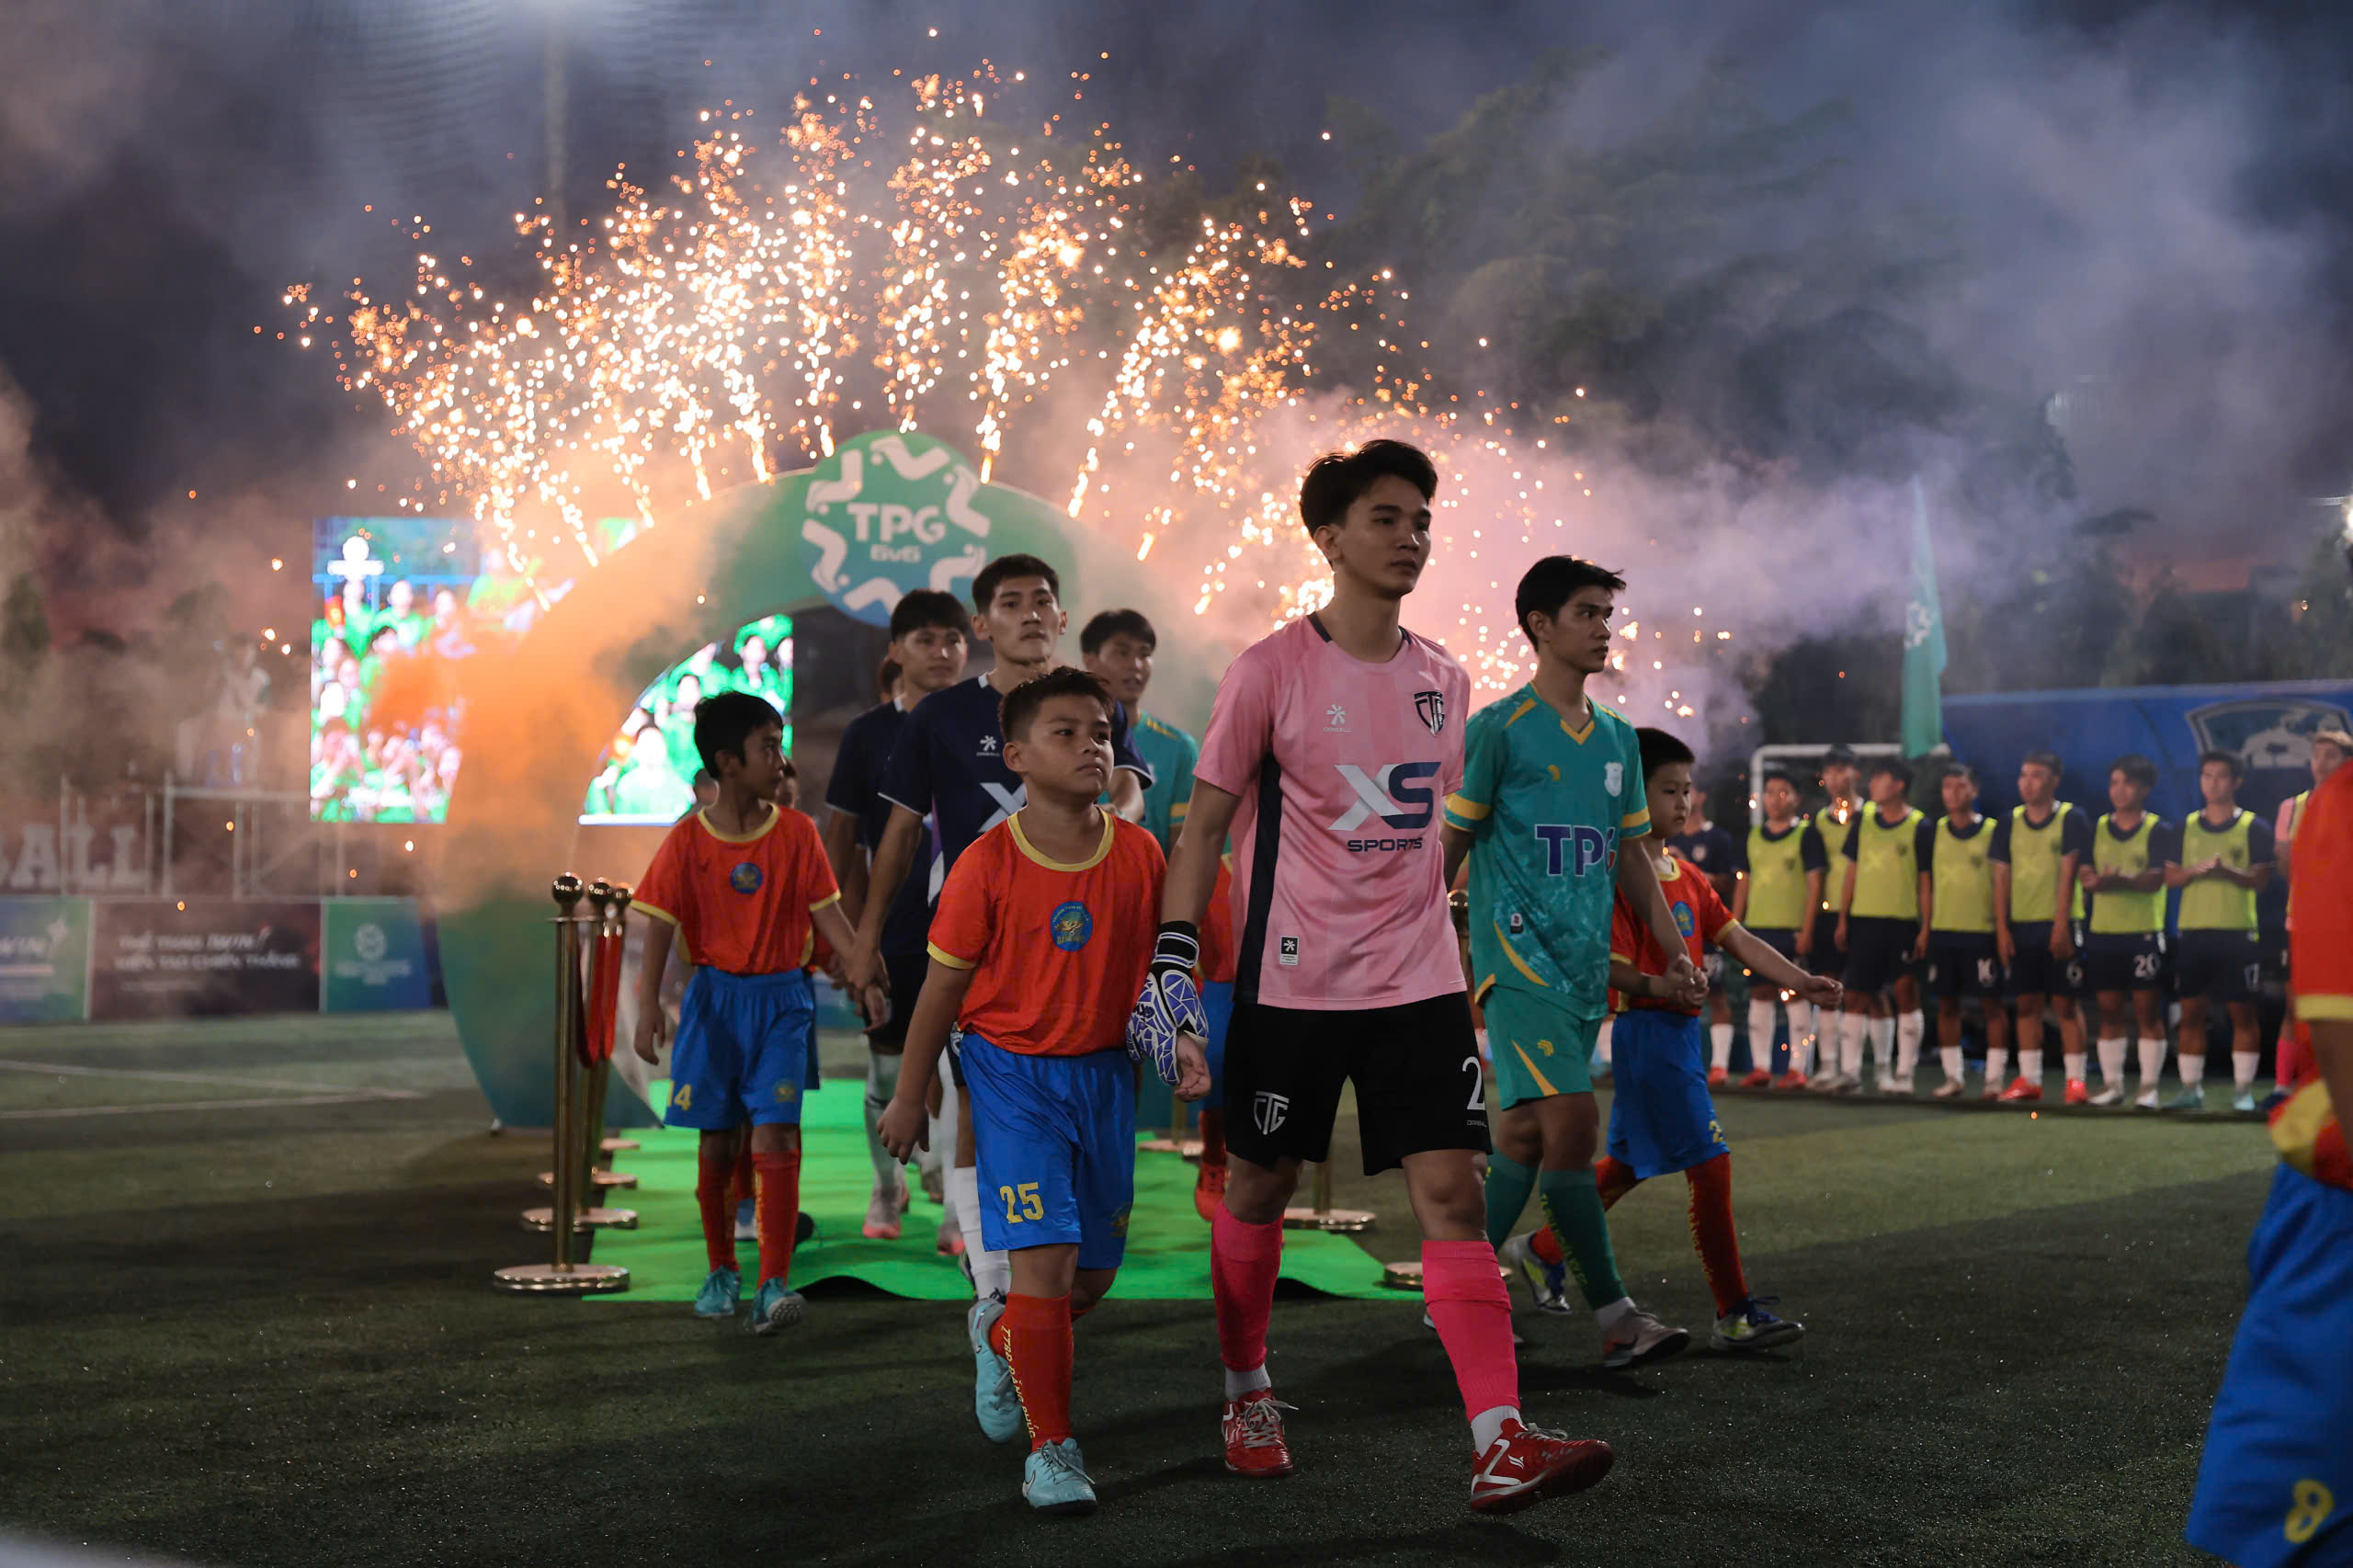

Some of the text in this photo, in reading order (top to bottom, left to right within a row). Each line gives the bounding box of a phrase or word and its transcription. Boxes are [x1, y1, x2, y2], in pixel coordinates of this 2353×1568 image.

[847, 502, 947, 544] TPG
[1327, 761, 1441, 832] XS
[1347, 837, 1423, 853] SPORTS
[2133, 952, 2161, 980] 20
[667, 1080, 691, 1110] 14
[999, 1181, 1044, 1224] 25
[2284, 1480, 2335, 1544] 8
